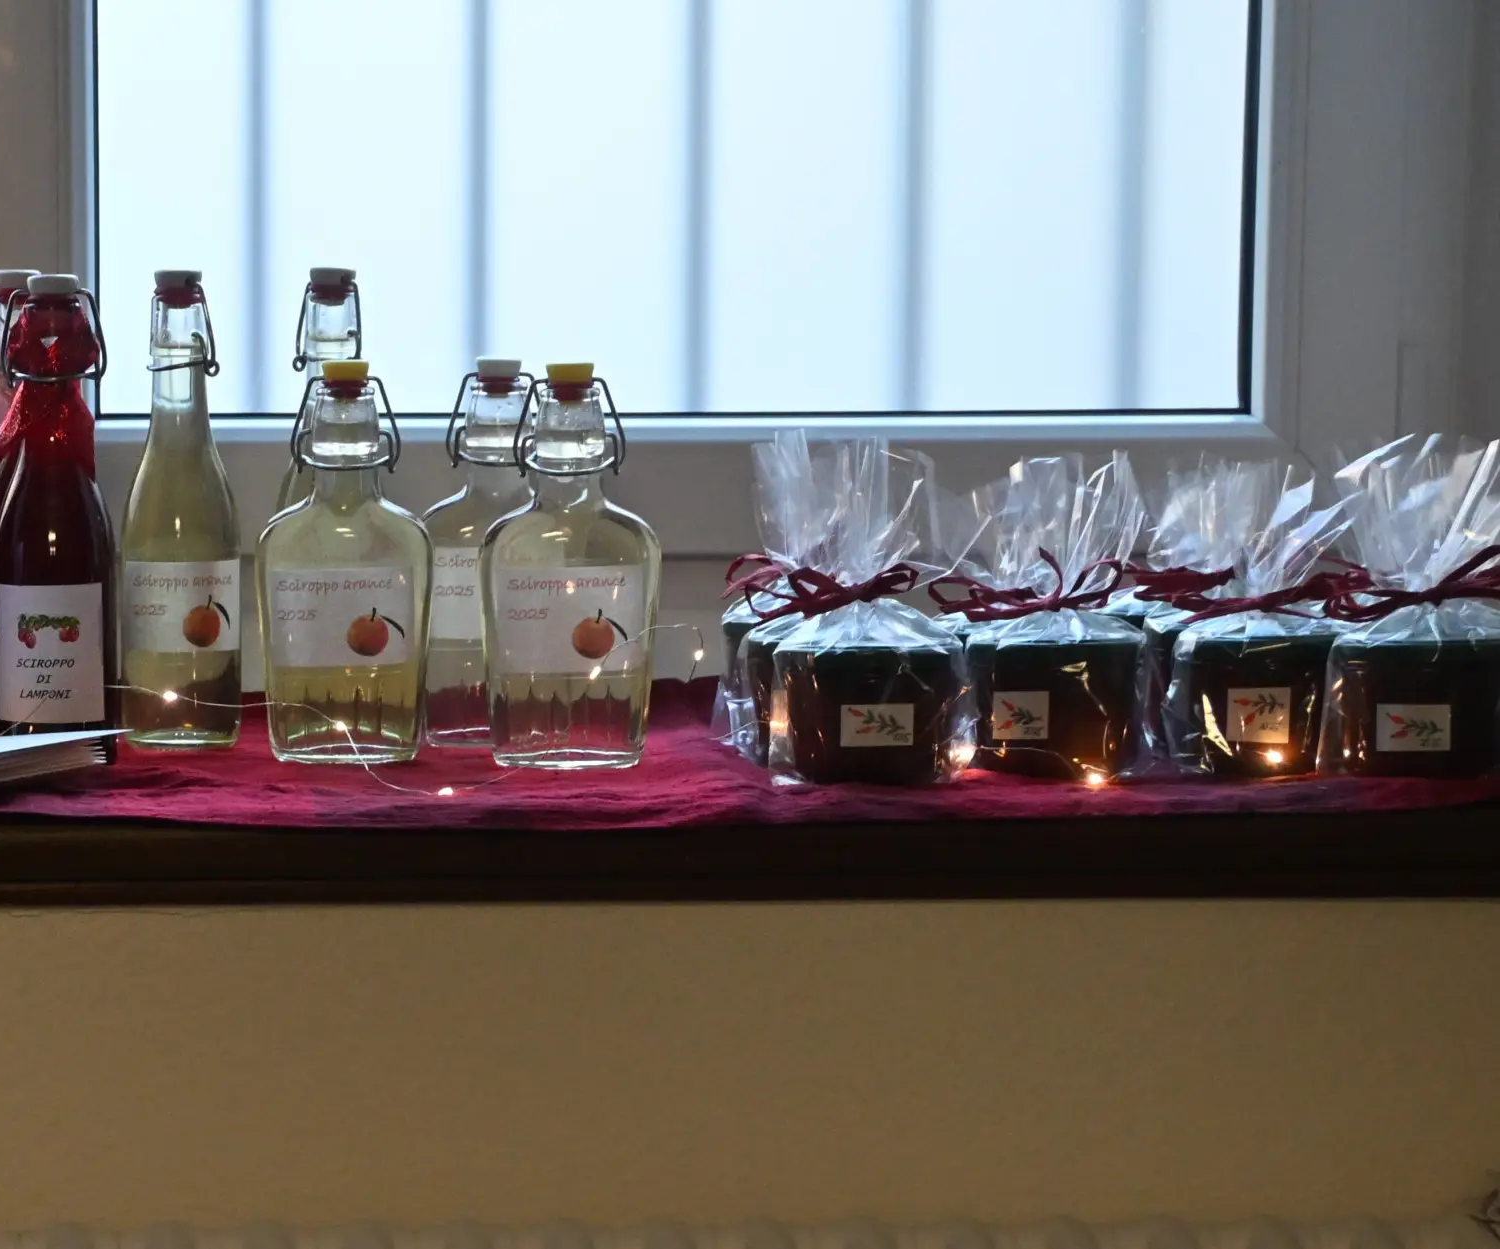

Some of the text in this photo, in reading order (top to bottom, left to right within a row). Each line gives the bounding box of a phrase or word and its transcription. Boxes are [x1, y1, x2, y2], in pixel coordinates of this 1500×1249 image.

[132, 574, 188, 592] Sciroppo
[276, 578, 339, 596] Sciroppo
[434, 584, 476, 597] 2025
[133, 604, 168, 616] 2025
[277, 609, 317, 621] 2025
[507, 607, 549, 620] 2025
[16, 658, 76, 669] SCIROPPO
[36, 674, 53, 684] DI
[20, 689, 72, 699] LAMPONI
